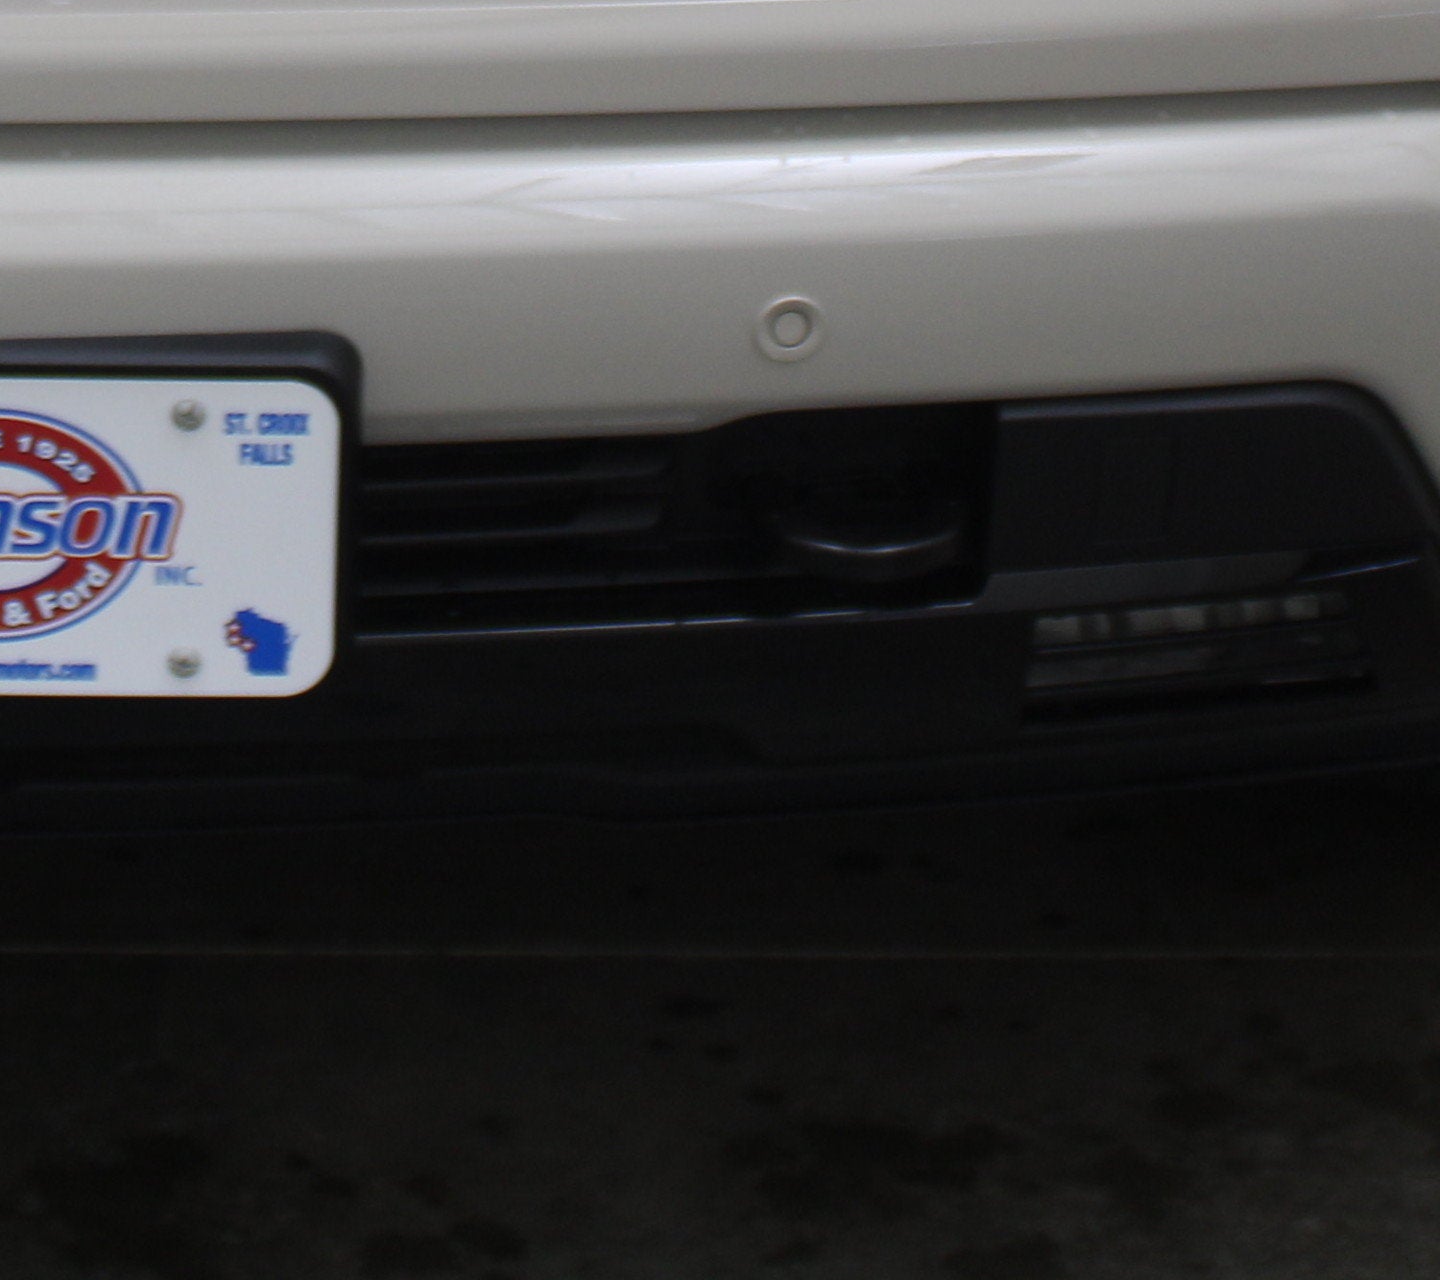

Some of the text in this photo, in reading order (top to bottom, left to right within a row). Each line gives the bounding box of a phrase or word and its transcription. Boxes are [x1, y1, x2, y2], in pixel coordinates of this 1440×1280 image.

[239, 443, 294, 467] FALLS
[1, 597, 33, 628] &
[34, 561, 113, 620] Ford
